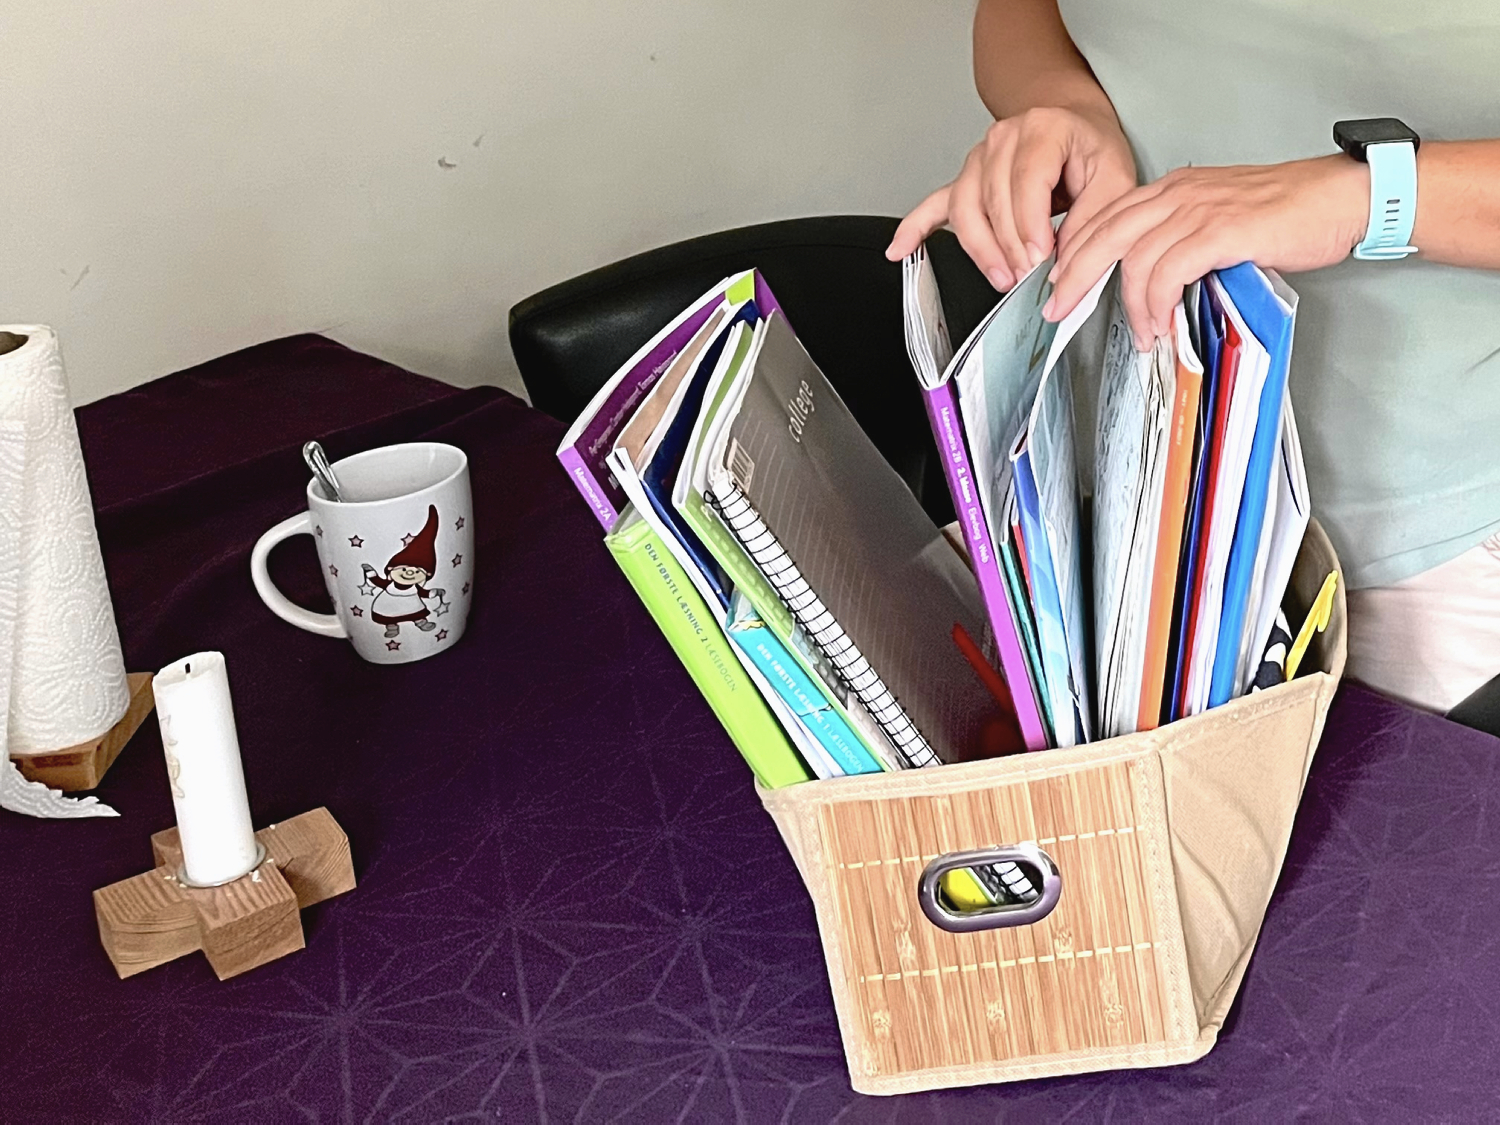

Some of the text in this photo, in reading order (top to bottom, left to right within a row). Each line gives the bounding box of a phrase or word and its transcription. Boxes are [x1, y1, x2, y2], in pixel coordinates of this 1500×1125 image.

[788, 380, 815, 443] college
[573, 466, 603, 510] Matematrix
[598, 502, 612, 521] 2A
[940, 406, 958, 450] Matematrix
[951, 448, 963, 464] 2B
[967, 506, 983, 541] Elevbog
[978, 544, 990, 564] Web
[644, 543, 660, 561] DEN
[656, 563, 679, 595] FØRSTE
[676, 595, 704, 635] LÆSNING
[704, 643, 738, 692] LÆSEBOGEN
[756, 643, 773, 661] DEN
[770, 659, 796, 690] FØRSTE
[827, 729, 864, 773] LÆSEBOGEN
